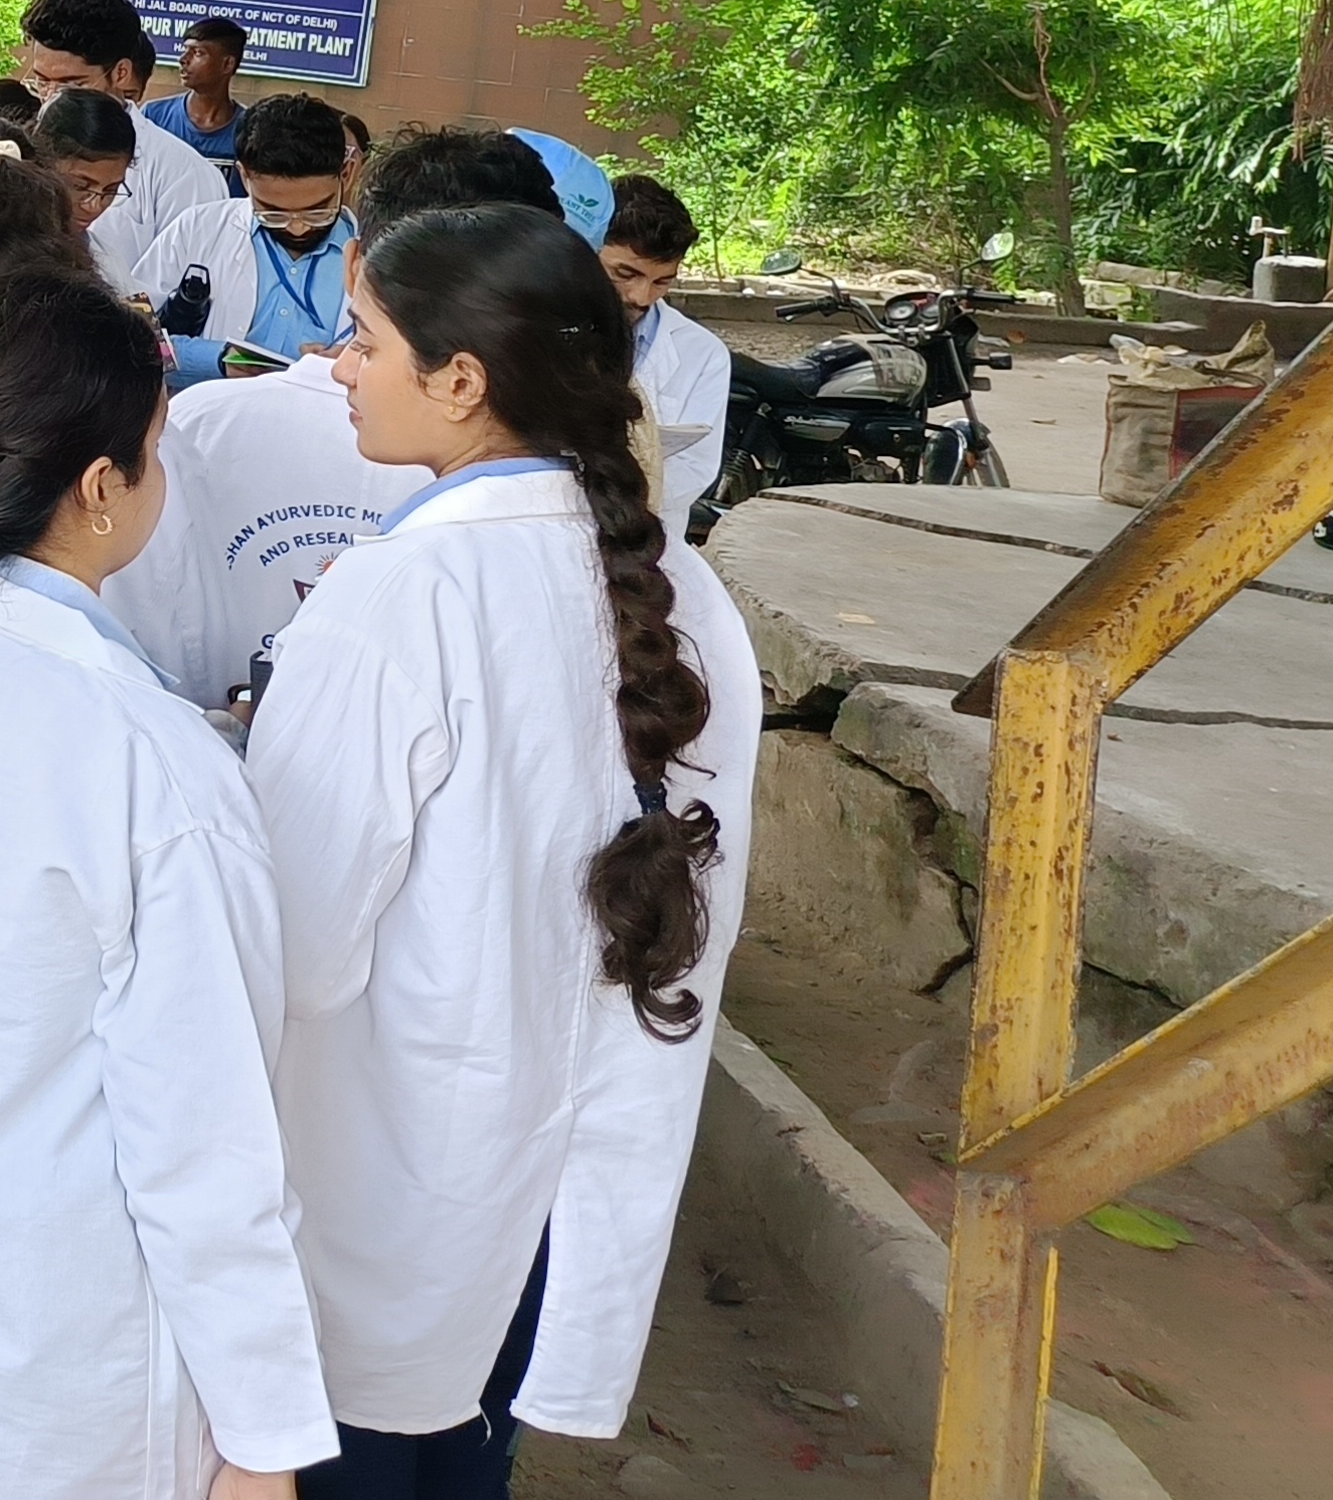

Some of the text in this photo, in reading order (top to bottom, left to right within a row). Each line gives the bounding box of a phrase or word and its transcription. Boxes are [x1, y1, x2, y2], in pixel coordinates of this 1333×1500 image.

[147, 0, 167, 11] JAL
[169, 2, 207, 15] BOARD
[208, 6, 242, 19] (GOVT.
[244, 10, 260, 20] OF
[262, 11, 285, 23] NCT
[285, 14, 301, 25] OF
[302, 16, 338, 31] DELHI)
[242, 26, 354, 57] EATMENT PLANT
[242, 50, 267, 61] ELHI
[226, 525, 255, 570] SHAN
[256, 504, 356, 530] AYURVEDIC
[259, 532, 354, 567] AND RESEA
